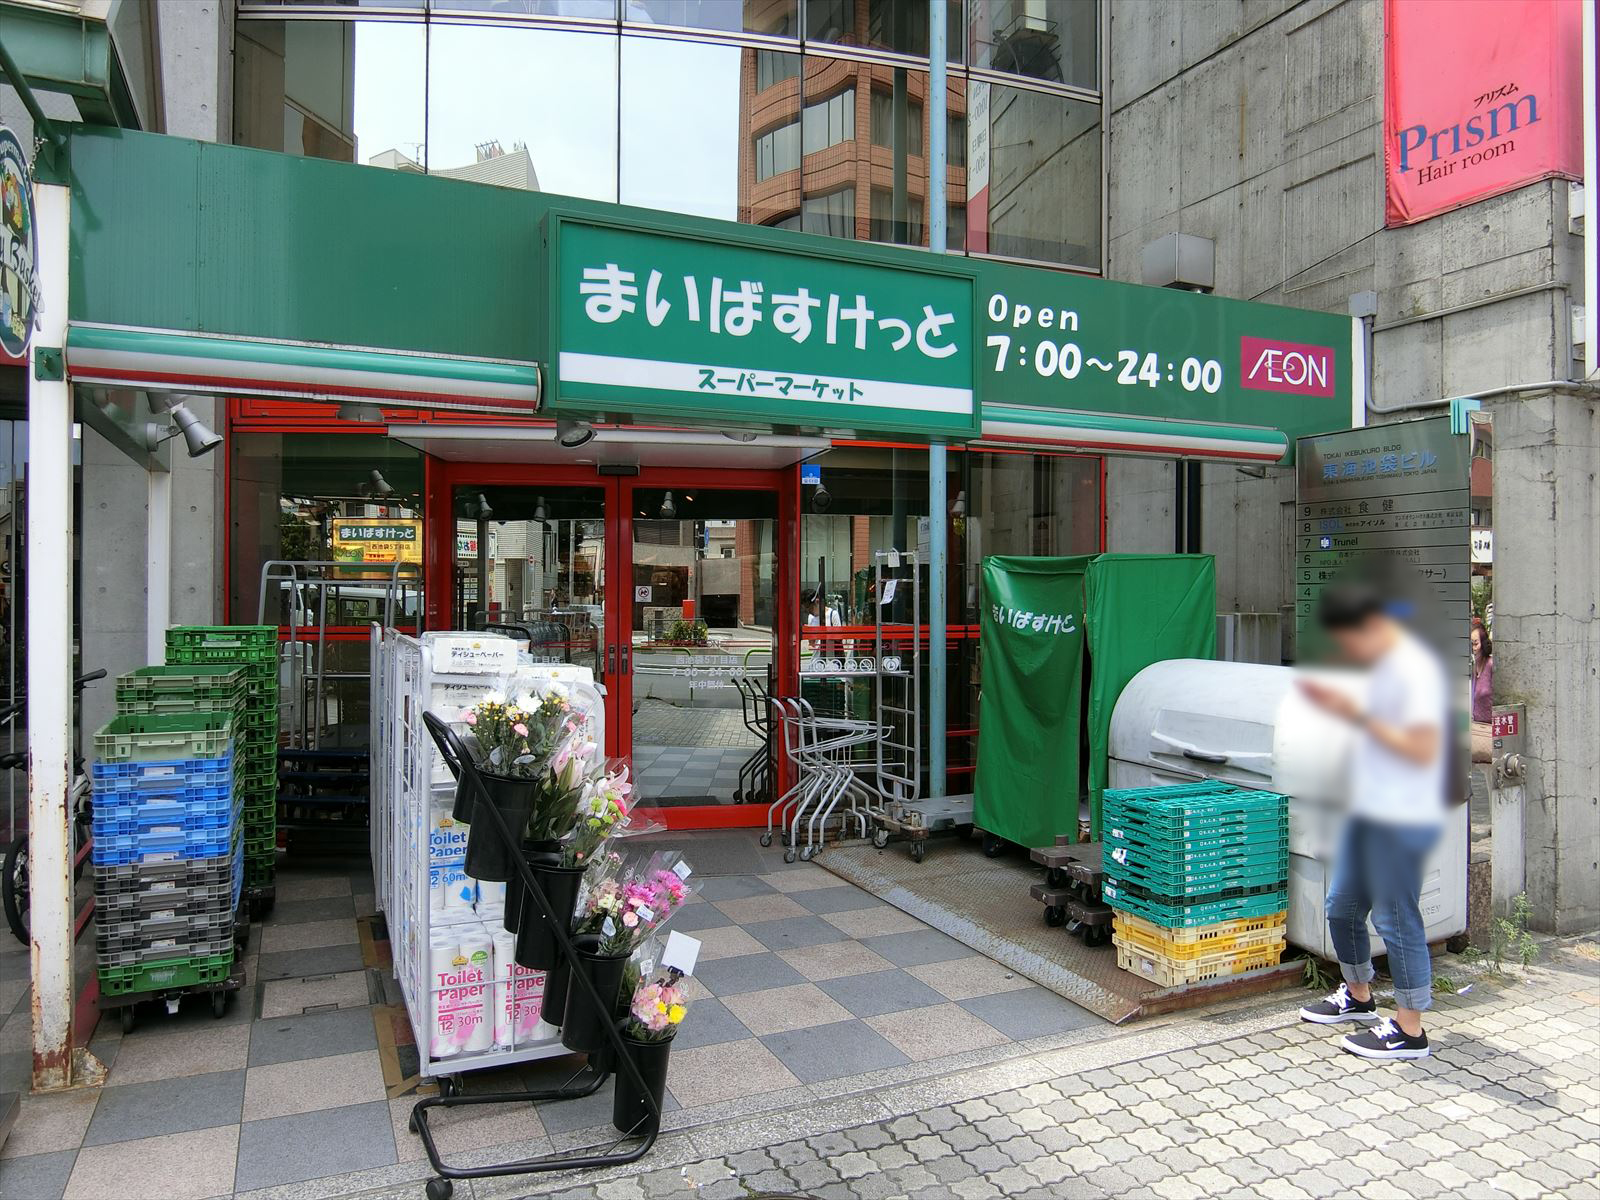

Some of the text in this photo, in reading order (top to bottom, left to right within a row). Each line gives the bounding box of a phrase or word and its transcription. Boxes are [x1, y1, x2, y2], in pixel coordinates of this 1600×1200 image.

[1395, 94, 1541, 174] Prism
[1417, 139, 1516, 186] Hair room
[579, 263, 959, 359] まいばすけっと
[988, 293, 1079, 332] Open
[698, 369, 864, 402] スーパーマーケット
[1323, 452, 1342, 460] TOKAI
[1344, 446, 1381, 457] IKEBUKURO
[1322, 450, 1438, 480] 東海池袋ビル
[1303, 506, 1312, 517] 9
[340, 527, 414, 539] まいばすけっと
[1303, 523, 1311, 532] 8
[1303, 537, 1358, 548] 7 Trunel
[1303, 554, 1311, 564] 6
[1303, 570, 1311, 581] 5
[1303, 587, 1311, 597] 4
[1303, 603, 1311, 614] 3
[1491, 714, 1514, 727] 送水管
[429, 831, 467, 845] Toilet
[430, 875, 439, 886] 2
[438, 969, 483, 987] Toilet
[506, 976, 545, 991] Pape
[438, 983, 486, 1001] Paper
[507, 1009, 520, 1021] 12
[439, 1020, 453, 1031] 12
[457, 1015, 483, 1028] 30m
